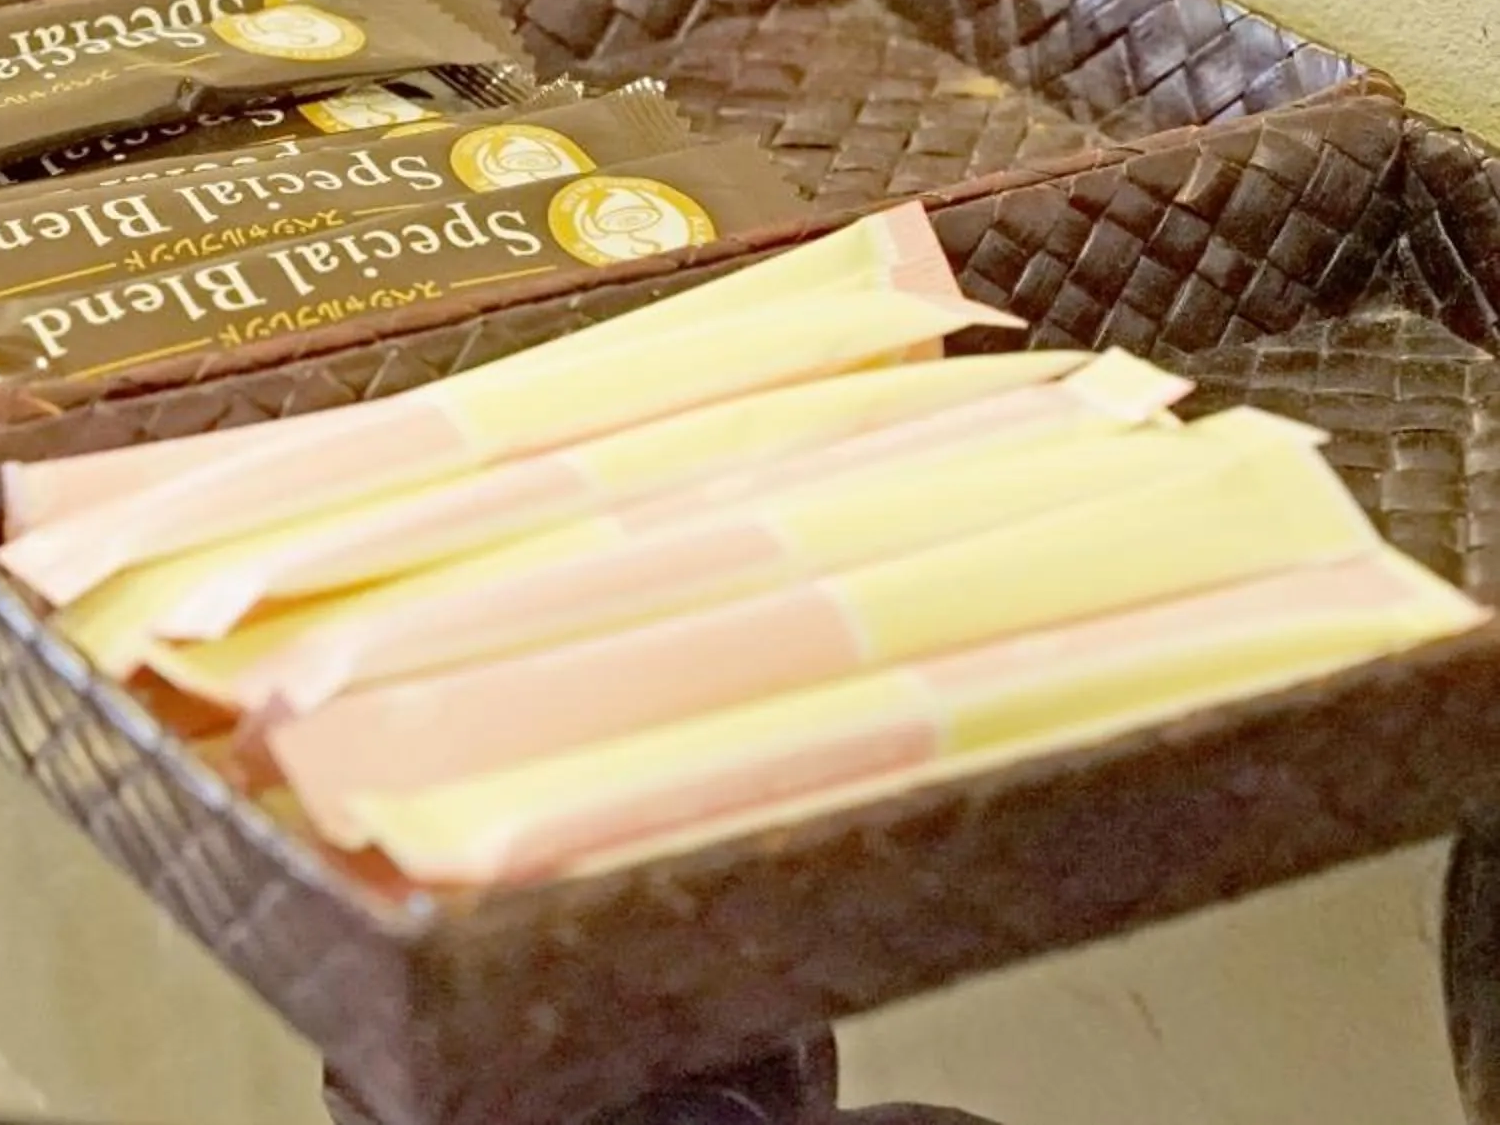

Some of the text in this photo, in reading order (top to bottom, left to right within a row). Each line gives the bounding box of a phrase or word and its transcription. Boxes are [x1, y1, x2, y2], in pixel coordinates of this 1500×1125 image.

[181, 142, 445, 223] Special
[121, 208, 345, 278] スペシャルブレンド
[261, 198, 542, 296] Special
[22, 259, 267, 359] Blend
[214, 278, 444, 349] スペシャルブレンド
